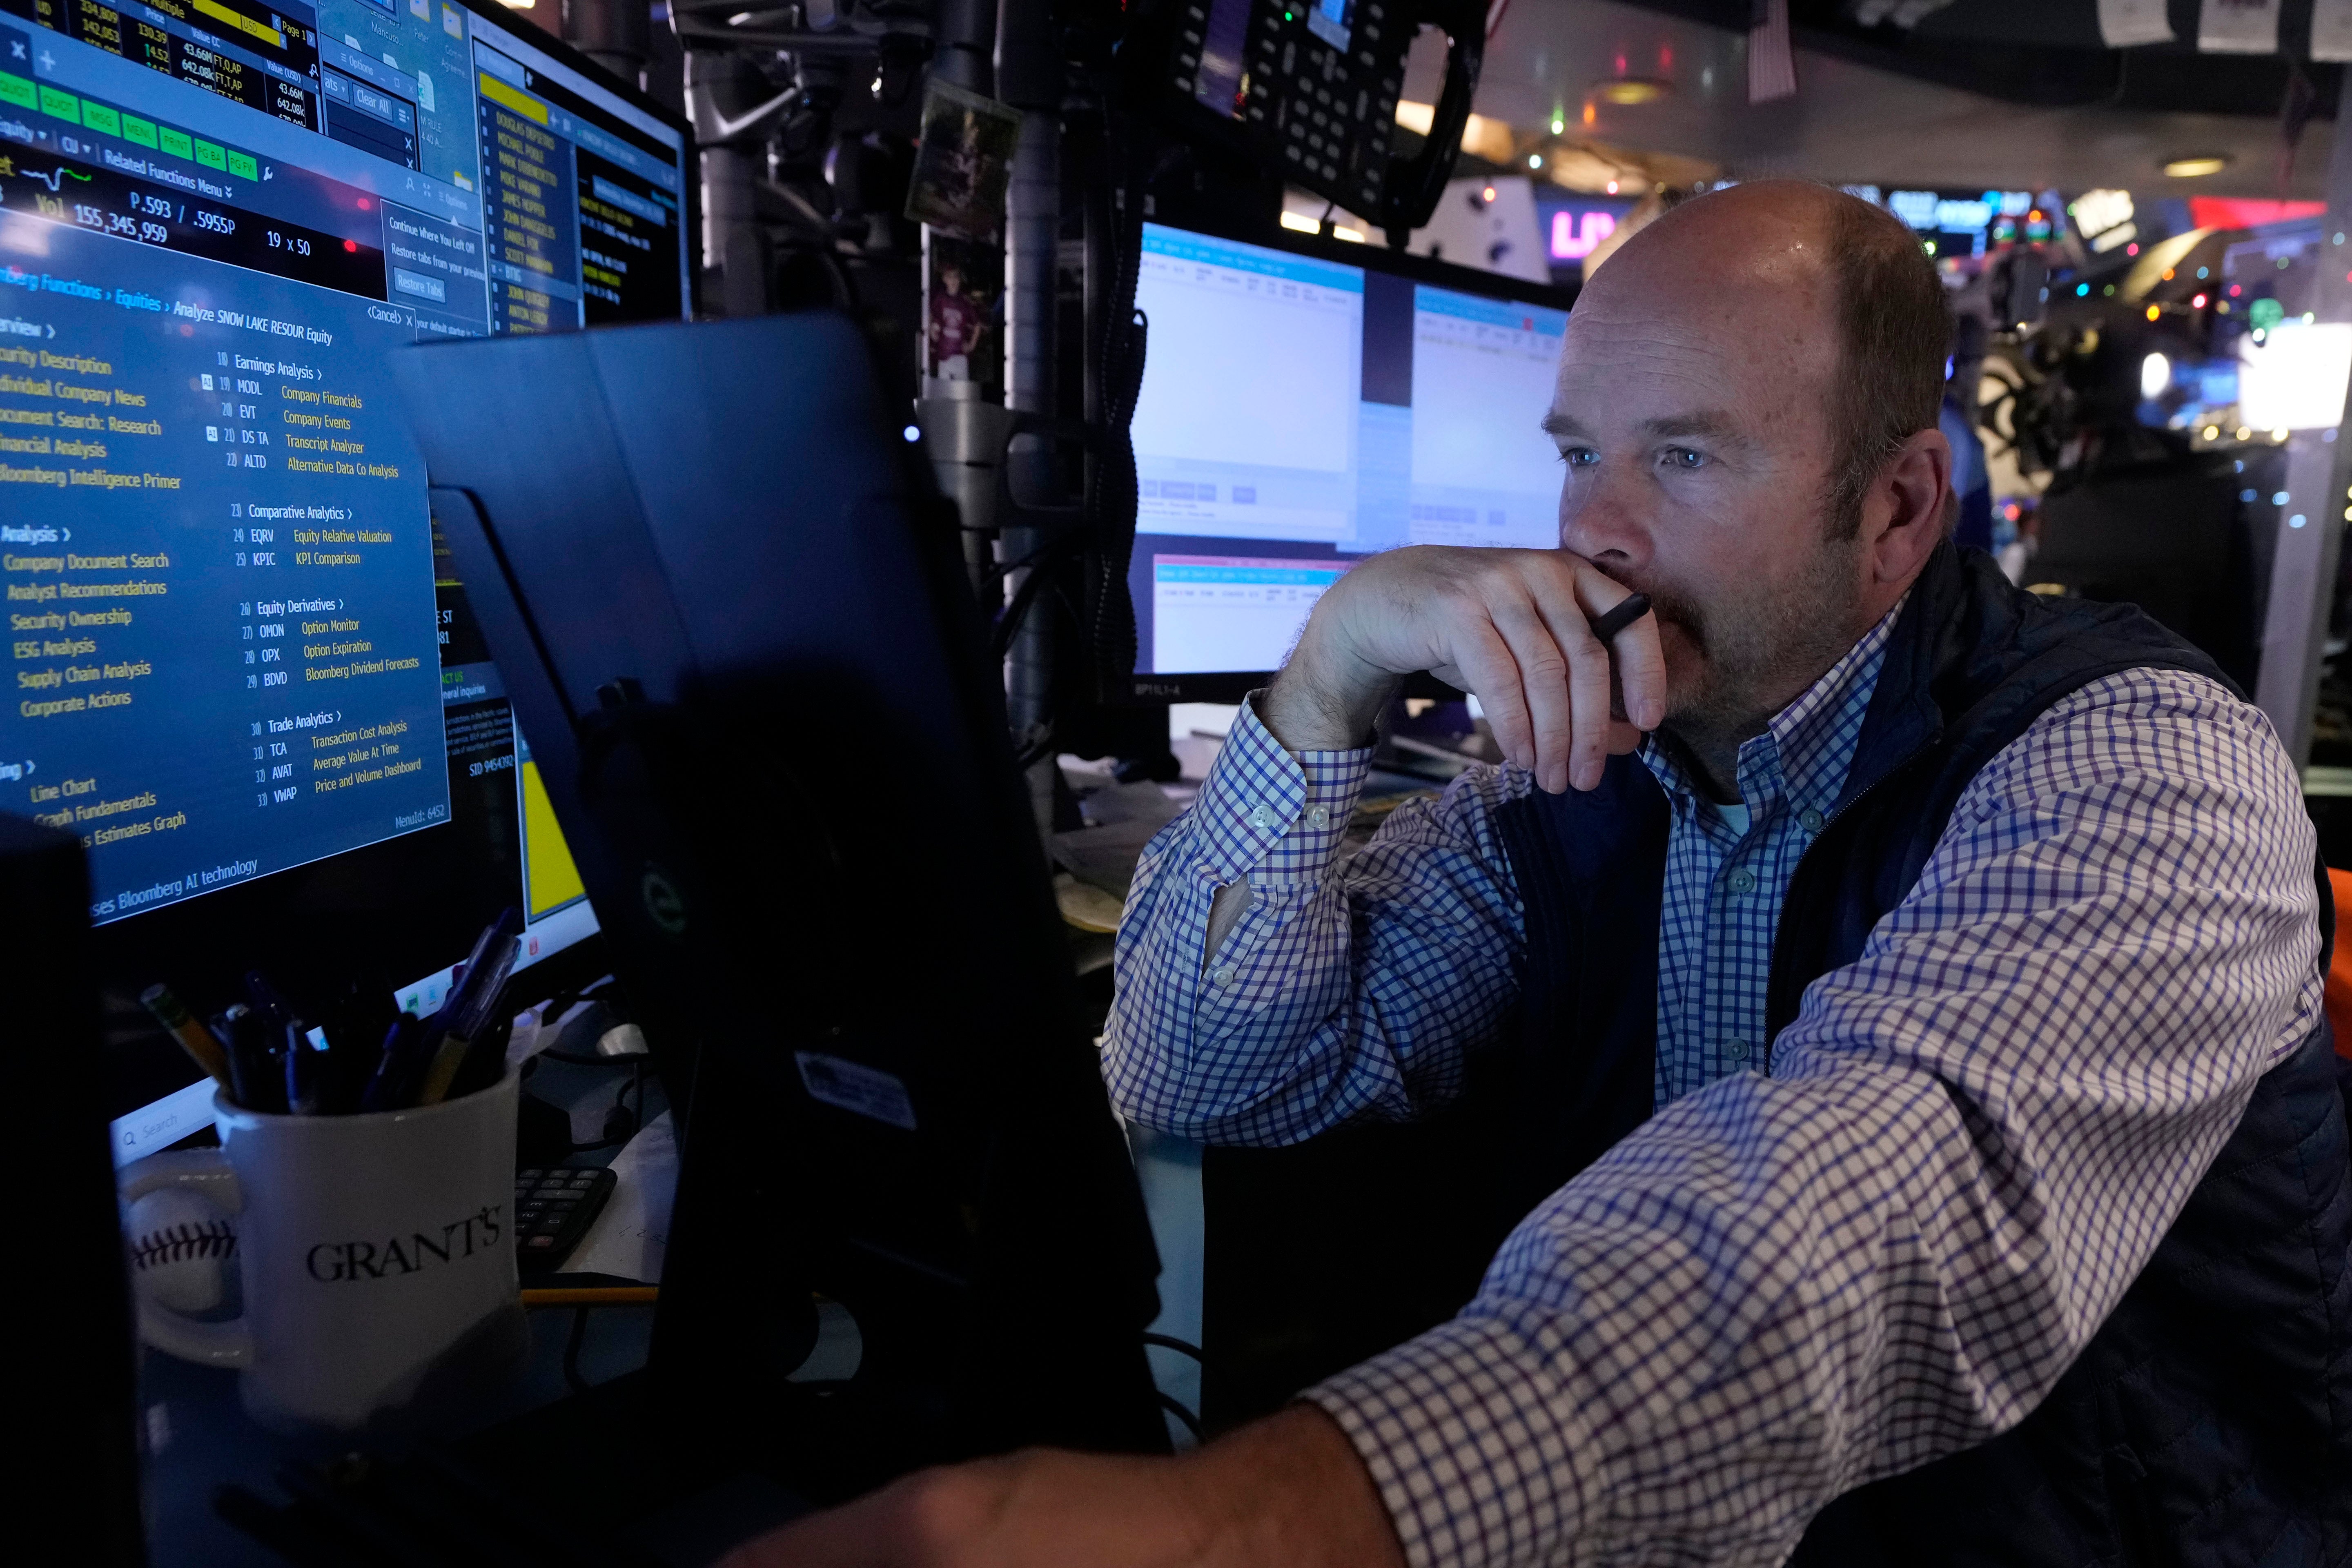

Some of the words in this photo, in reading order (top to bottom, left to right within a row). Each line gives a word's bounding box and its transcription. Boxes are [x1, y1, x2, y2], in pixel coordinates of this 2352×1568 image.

[191, 26, 210, 44] Value
[244, 17, 257, 33] USD
[283, 20, 299, 38] Page
[302, 30, 306, 40] 1
[414, 28, 428, 42] Peter
[183, 43, 212, 63] 43.66M
[214, 55, 242, 73] FT,Q,AP
[349, 54, 373, 76] Options
[182, 60, 214, 81] 642.08k
[216, 72, 242, 91] FT,T,AP
[267, 60, 283, 75] Value
[285, 68, 301, 83] (USD)
[279, 83, 303, 101] 43.66M
[357, 89, 375, 105] Clear
[379, 99, 388, 113] All
[277, 98, 305, 118] 642.08k
[164, 135, 188, 151] PRINT
[198, 147, 209, 159] PG
[211, 151, 221, 162] BA
[105, 149, 147, 174] Related
[149, 163, 196, 189] Functions
[198, 182, 222, 198] Menu
[230, 157, 241, 169] PG
[35, 193, 66, 218] Vol
[74, 204, 167, 243] 155,345,959
[267, 231, 280, 247] 19
[298, 240, 310, 256] 50
[390, 217, 418, 236] Continue
[419, 225, 438, 243] Where
[440, 234, 452, 247] You
[453, 237, 464, 251] Left
[392, 243, 416, 261] Restore
[419, 252, 431, 264] tabs
[433, 256, 447, 270] from
[449, 262, 462, 274] your
[398, 274, 425, 292] Restore
[428, 283, 442, 297] Tabs
[42, 274, 101, 301] Functions
[115, 289, 161, 312] Equities
[174, 301, 214, 322] Analyze
[218, 310, 244, 327] SNOW
[246, 316, 268, 332] LAKE
[271, 320, 304, 339] RESOUR
[307, 330, 332, 346] Equity
[367, 307, 401, 325] <Cancel>
[40, 350, 112, 375] Description
[235, 354, 275, 376] Earnings
[278, 361, 314, 380] Analysis
[55, 381, 111, 406] Company
[115, 388, 146, 408] News
[237, 379, 262, 396] MODL
[282, 386, 319, 405] Company
[323, 391, 362, 409] Financials
[56, 411, 105, 430] Search:
[108, 416, 162, 435] Research
[240, 405, 256, 419] EVT
[284, 411, 321, 430] Company
[325, 415, 350, 430] Events
[55, 439, 107, 459] Analysis
[243, 430, 254, 444] DS
[256, 432, 269, 445] TA
[286, 434, 328, 451] Transcript
[331, 439, 364, 454] Analyzer
[245, 454, 266, 468] ALTD
[288, 457, 334, 474] Alternative
[336, 462, 354, 475] Data
[356, 463, 366, 476] Co
[369, 464, 398, 479] Analysis
[69, 469, 141, 490] Intelligence
[143, 473, 181, 489] Primer
[249, 503, 305, 521] Comparative
[307, 506, 344, 521] Analytics
[1, 524, 58, 546] Analysis
[251, 529, 274, 545] EQRV
[294, 529, 319, 545] Equity
[322, 529, 355, 542] Relative
[357, 530, 391, 543] Valuation
[3, 554, 65, 572] Company
[67, 554, 128, 570] Document
[131, 552, 169, 568] Search
[253, 552, 276, 566] KPIC
[296, 552, 311, 565] KPI
[314, 551, 360, 566] Comparison
[8, 583, 57, 603] Analyst
[60, 580, 167, 598] Recommendations
[10, 611, 66, 630] Security
[69, 608, 132, 626] Ownership
[258, 601, 285, 617] Equity
[288, 598, 335, 613] Derivatives
[443, 609, 453, 624] ST
[260, 624, 284, 638] OMON
[302, 621, 328, 636] Option
[331, 618, 359, 633] Monitor
[13, 641, 40, 659] ESG
[43, 637, 96, 657] Analysis
[262, 648, 280, 662] OPX
[304, 644, 330, 659] Option
[333, 640, 371, 656] Expiration
[17, 668, 62, 689] Supply
[65, 664, 100, 683] Chain
[104, 660, 151, 679] Analysis
[264, 671, 287, 687] BDVD
[306, 666, 349, 681] Bloomberg
[352, 659, 383, 676] Dividend
[386, 657, 419, 671] Forecasts
[21, 697, 85, 717] Corporate
[88, 690, 131, 708] Actions
[268, 717, 293, 733] Trade
[296, 712, 333, 730] Analytics
[270, 742, 287, 757] TCA
[312, 731, 357, 748] Transaction
[360, 726, 375, 740] Cost
[378, 720, 407, 737] Analysis
[273, 764, 292, 780] AVAT
[314, 754, 346, 771] Average
[348, 749, 369, 764] Value
[371, 746, 379, 758] At
[381, 744, 399, 756] Time
[30, 784, 60, 803] Line
[62, 778, 96, 797] Chart
[274, 787, 297, 803] VWAP
[315, 779, 336, 793] Price
[339, 773, 353, 788] and
[356, 768, 382, 784] Volume
[385, 758, 421, 777] Dashboard
[76, 792, 156, 820] Fundamentals
[396, 811, 425, 829] MenuId:
[427, 804, 445, 819] 6452
[95, 820, 151, 845] Estimates
[154, 811, 186, 831] Graph
[119, 880, 182, 910] Bloomberg
[186, 873, 198, 889] AI
[202, 859, 258, 885] technology
[143, 1113, 177, 1138] Search
